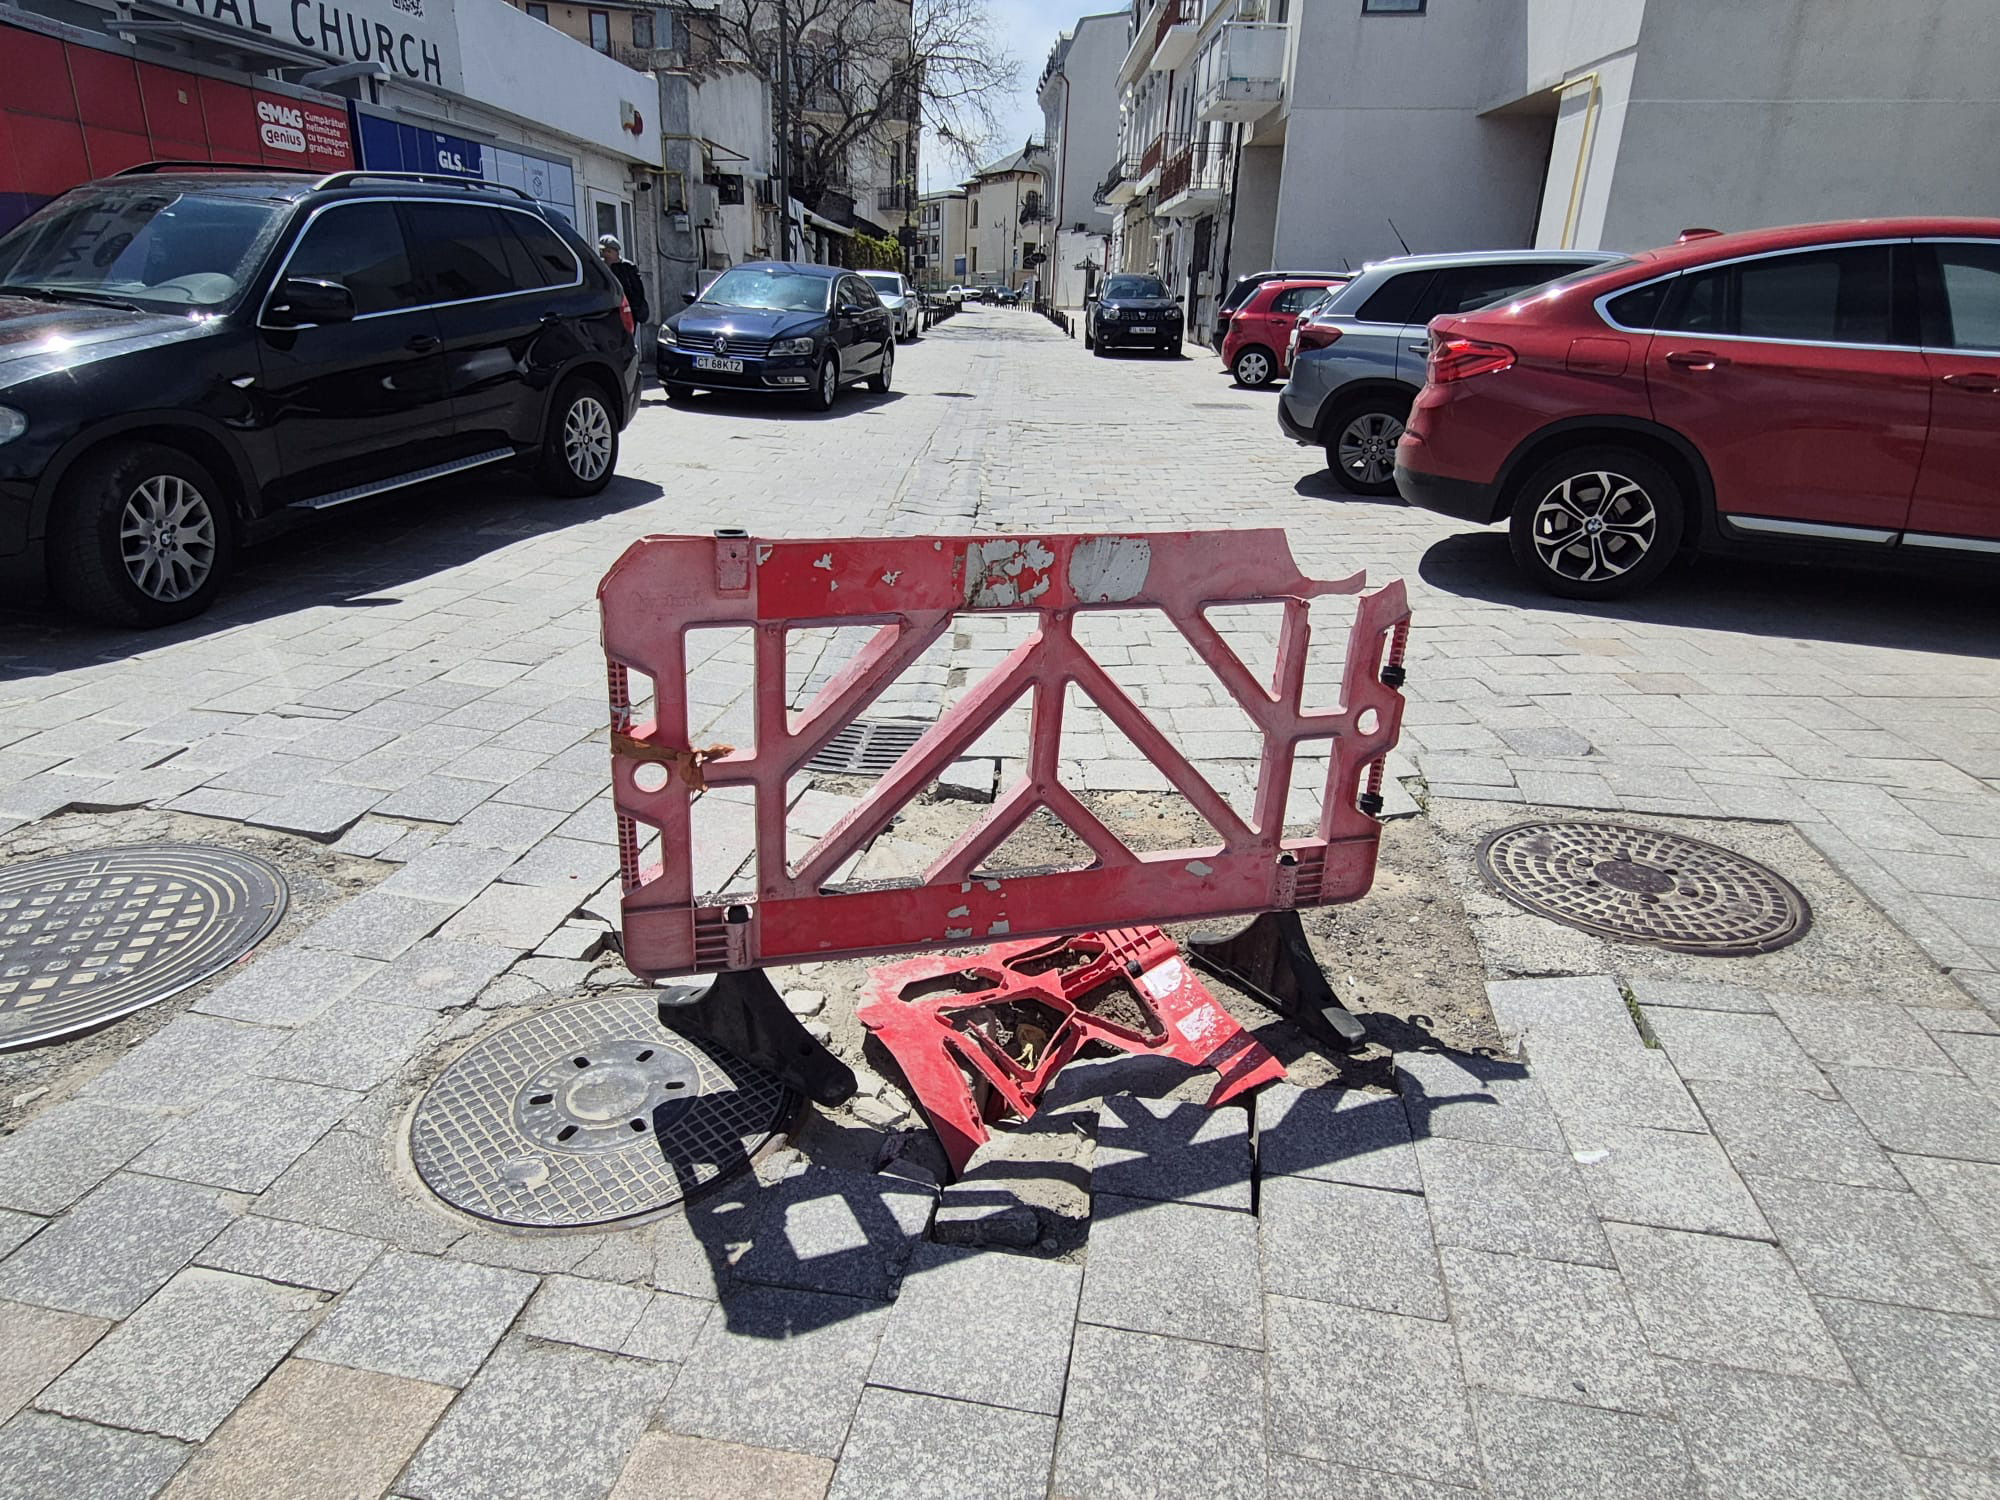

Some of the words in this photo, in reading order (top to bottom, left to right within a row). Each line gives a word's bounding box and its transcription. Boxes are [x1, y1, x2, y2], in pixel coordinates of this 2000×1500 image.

[291, 0, 441, 86] CHURCH
[265, 129, 302, 146] genius
[306, 123, 341, 138] nelimitate
[307, 133, 316, 142] cu
[316, 134, 350, 149] transport
[309, 143, 333, 156] gratuit
[333, 149, 346, 158] aici
[697, 358, 709, 368] CT
[711, 360, 741, 371] 68KTZ
